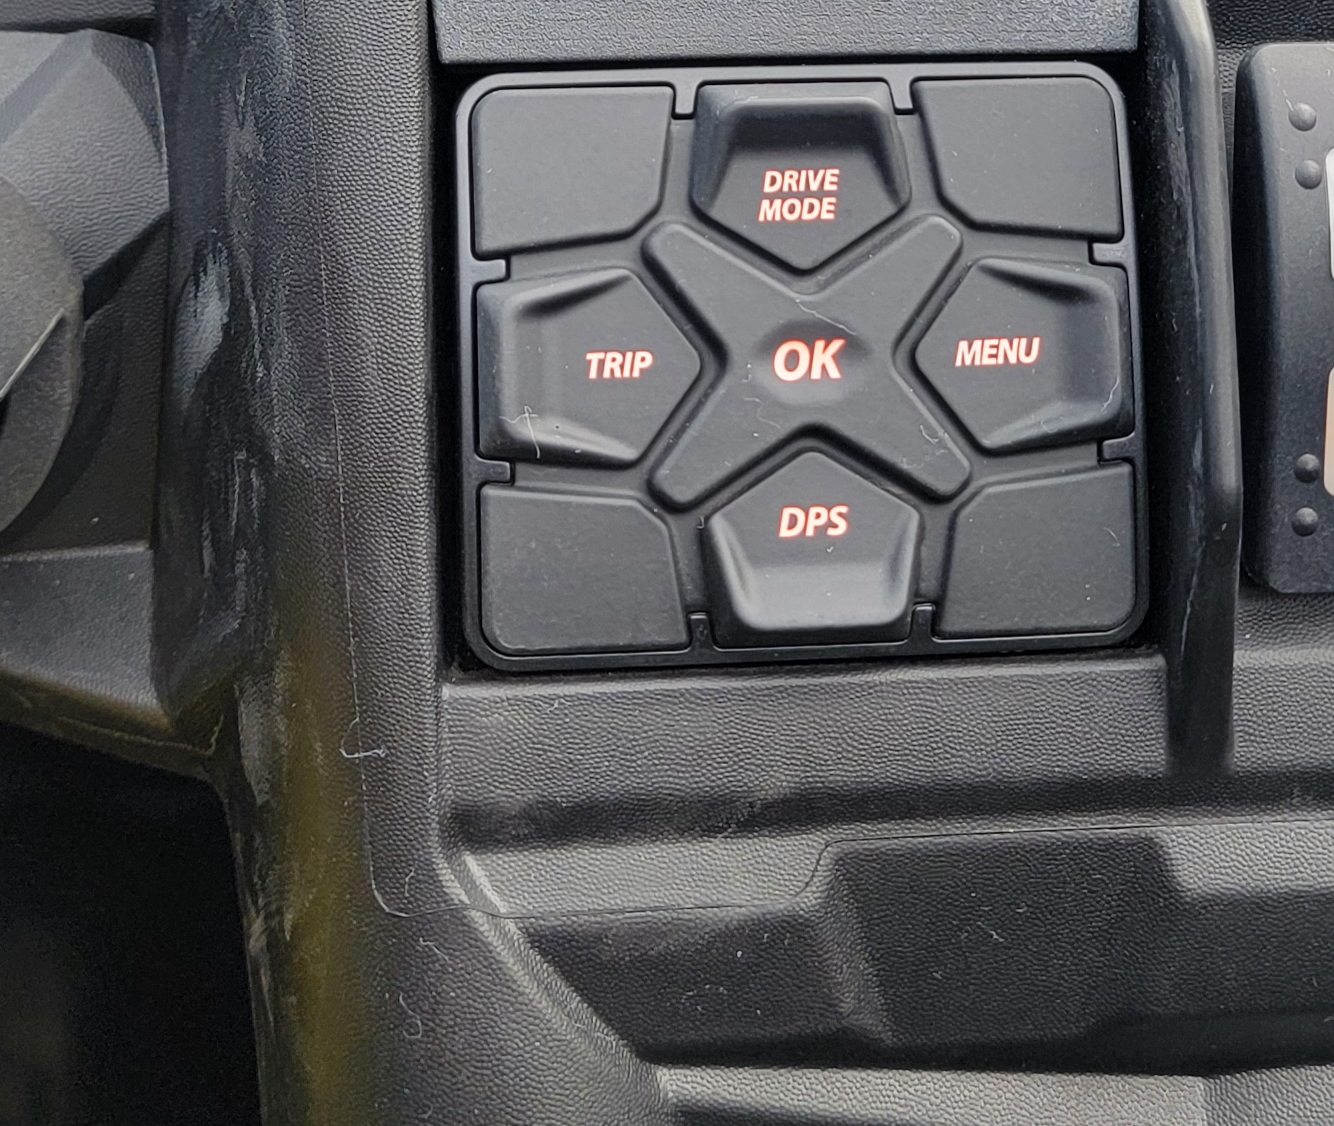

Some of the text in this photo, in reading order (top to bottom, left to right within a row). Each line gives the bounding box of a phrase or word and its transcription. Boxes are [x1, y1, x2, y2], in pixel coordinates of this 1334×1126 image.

[763, 169, 840, 194] DRIVE
[757, 197, 837, 223] MODE
[585, 350, 654, 380] TRIP
[772, 339, 845, 382] OK
[954, 336, 1041, 367] MENU
[777, 504, 849, 538] DPS
